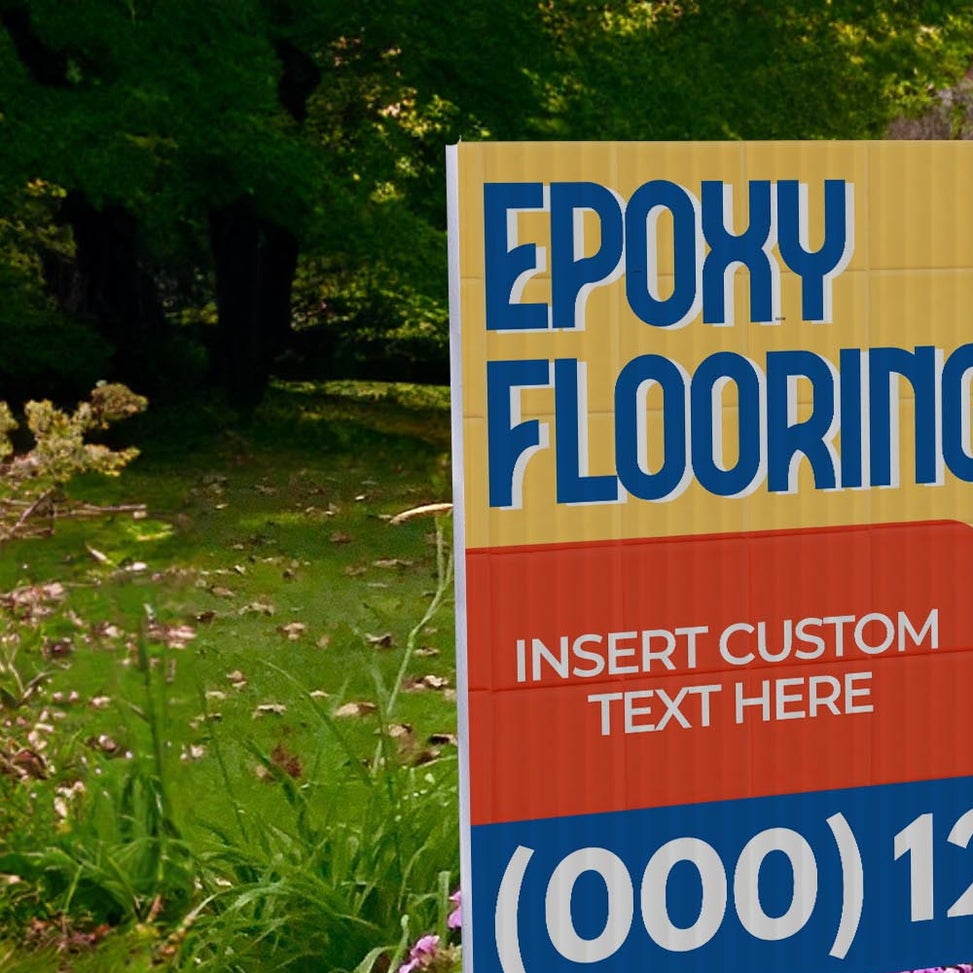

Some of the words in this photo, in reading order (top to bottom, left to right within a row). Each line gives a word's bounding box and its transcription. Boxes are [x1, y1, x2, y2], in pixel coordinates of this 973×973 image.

[484, 179, 855, 333] EPOXY
[516, 626, 709, 682] INSERT
[719, 608, 939, 665] CUSTOM
[587, 684, 722, 736] TEXT
[735, 671, 874, 724] HERE
